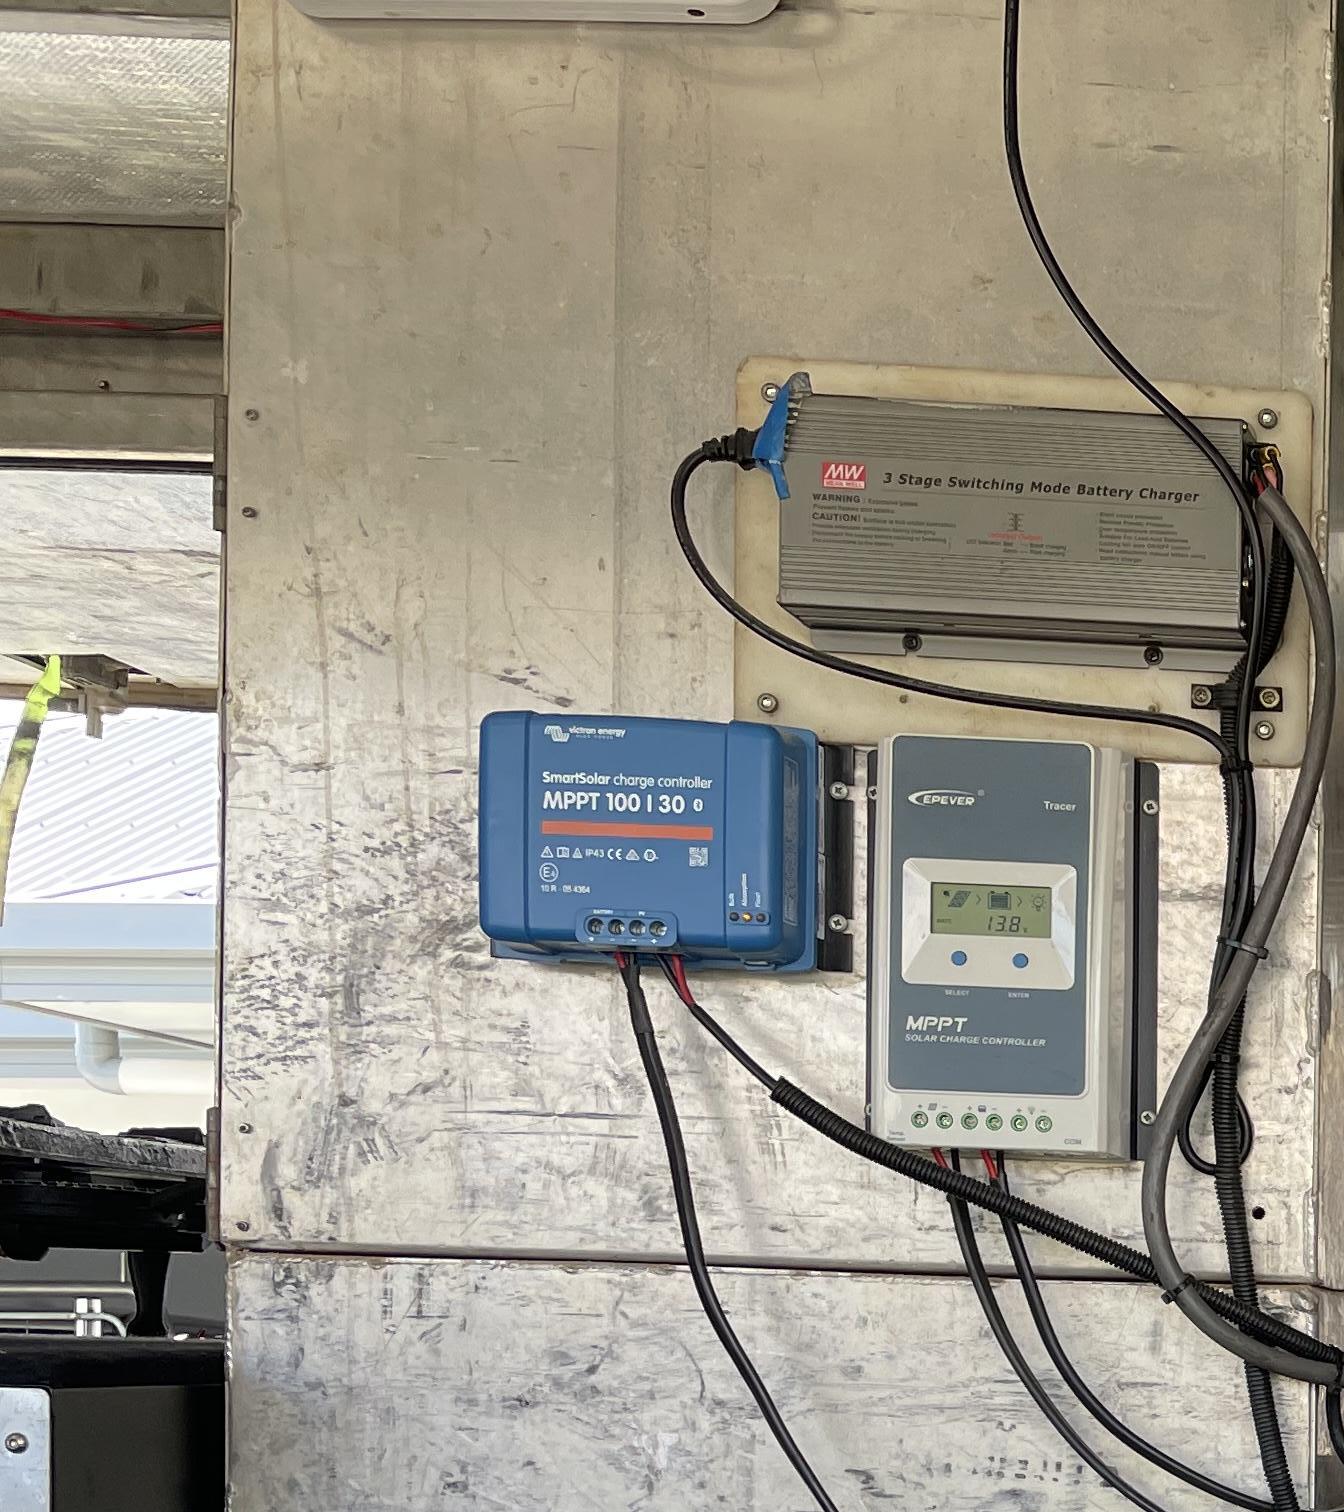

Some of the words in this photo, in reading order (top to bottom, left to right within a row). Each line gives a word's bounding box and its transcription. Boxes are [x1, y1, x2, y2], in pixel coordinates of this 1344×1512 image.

[824, 463, 865, 480] MW
[883, 472, 892, 484] 3
[898, 473, 943, 489] Stage
[948, 476, 1024, 494] Switching
[1030, 481, 1071, 494] Mode
[1076, 484, 1134, 500] Battery
[1139, 487, 1200, 503] Charger
[812, 493, 861, 504] WARNING
[598, 727, 626, 738] energy
[542, 771, 611, 785] SmartSolar
[613, 772, 655, 789] charge
[658, 776, 713, 789] controller
[543, 790, 601, 811] MPPT
[606, 792, 641, 812] 100
[658, 794, 685, 814] 30
[922, 794, 975, 806] EPEVER
[1043, 800, 1076, 811] Tracer
[585, 848, 604, 858] IP43
[988, 915, 1021, 933] 13.8
[1008, 991, 1030, 999] ENTER
[906, 1015, 968, 1032] MPPT
[905, 1033, 937, 1042] SOLAR
[940, 1034, 980, 1044] CHARGE
[982, 1036, 1047, 1047] CONTROLLER
